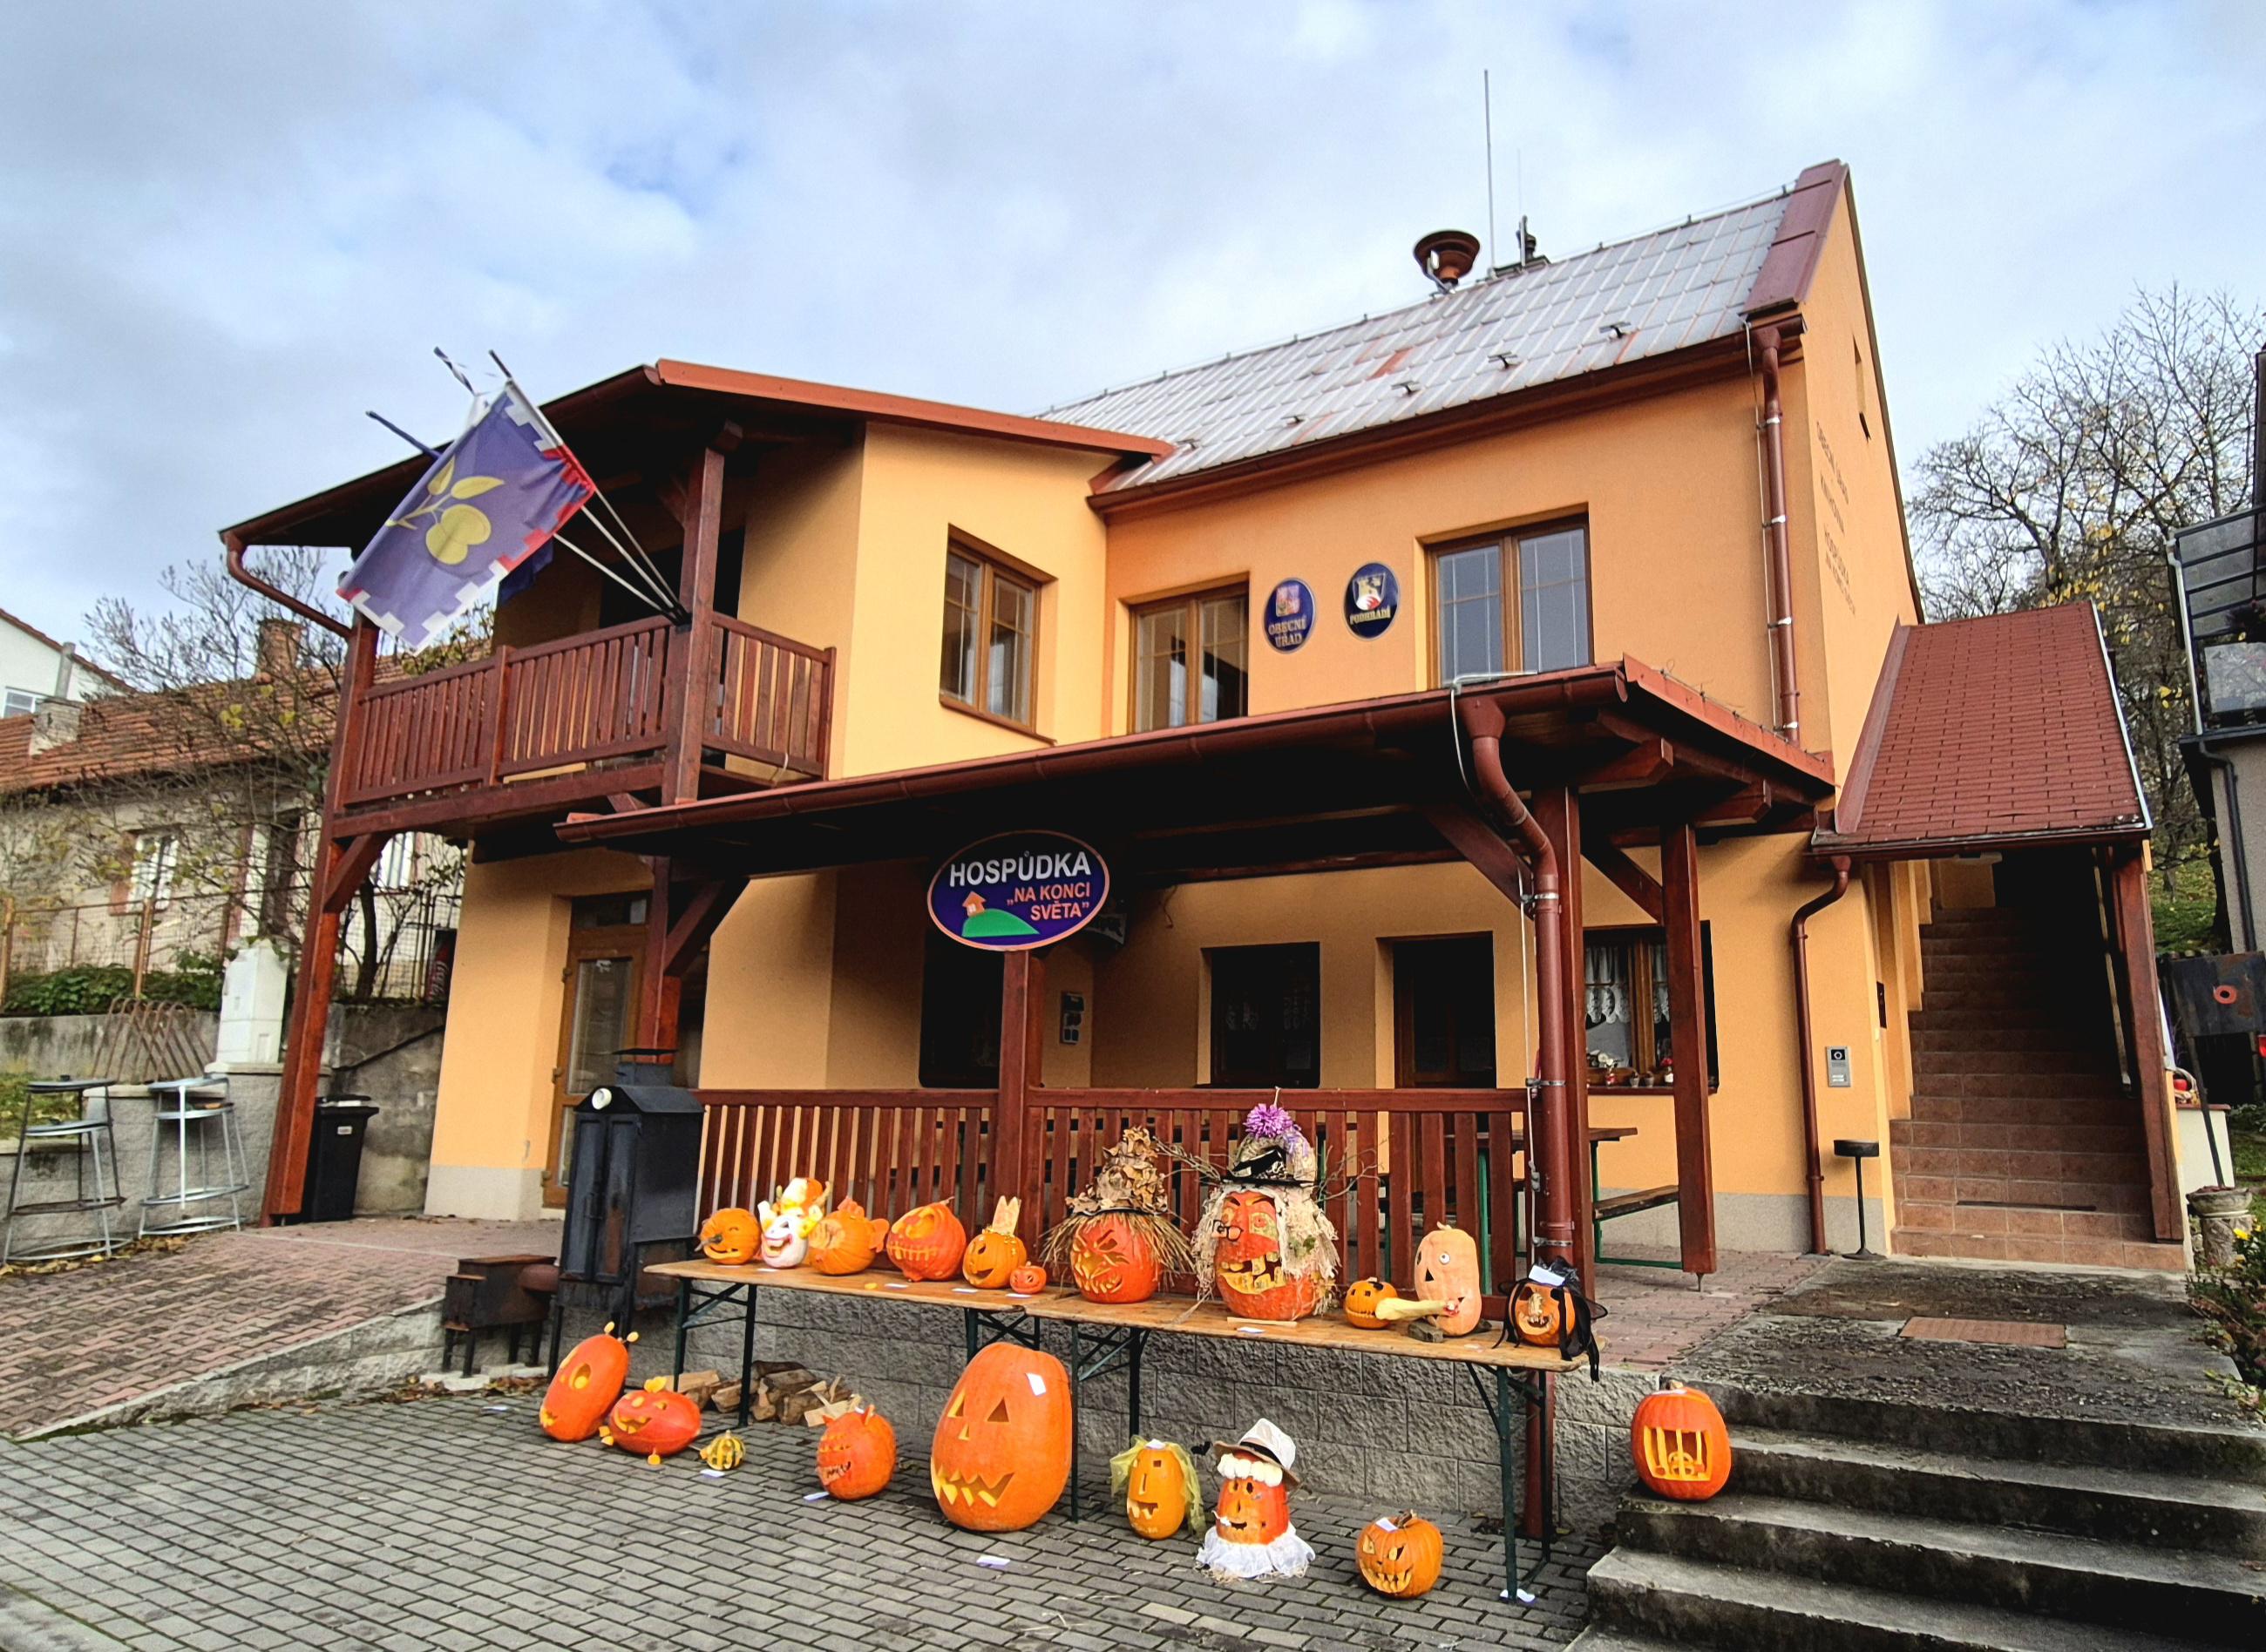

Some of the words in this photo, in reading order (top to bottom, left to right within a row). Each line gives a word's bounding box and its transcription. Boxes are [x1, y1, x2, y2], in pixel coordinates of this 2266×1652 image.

[1268, 615, 1306, 635] OBECNÍ
[950, 850, 1091, 887] HOSPŮDKA
[1040, 882, 1090, 900] KONCI
